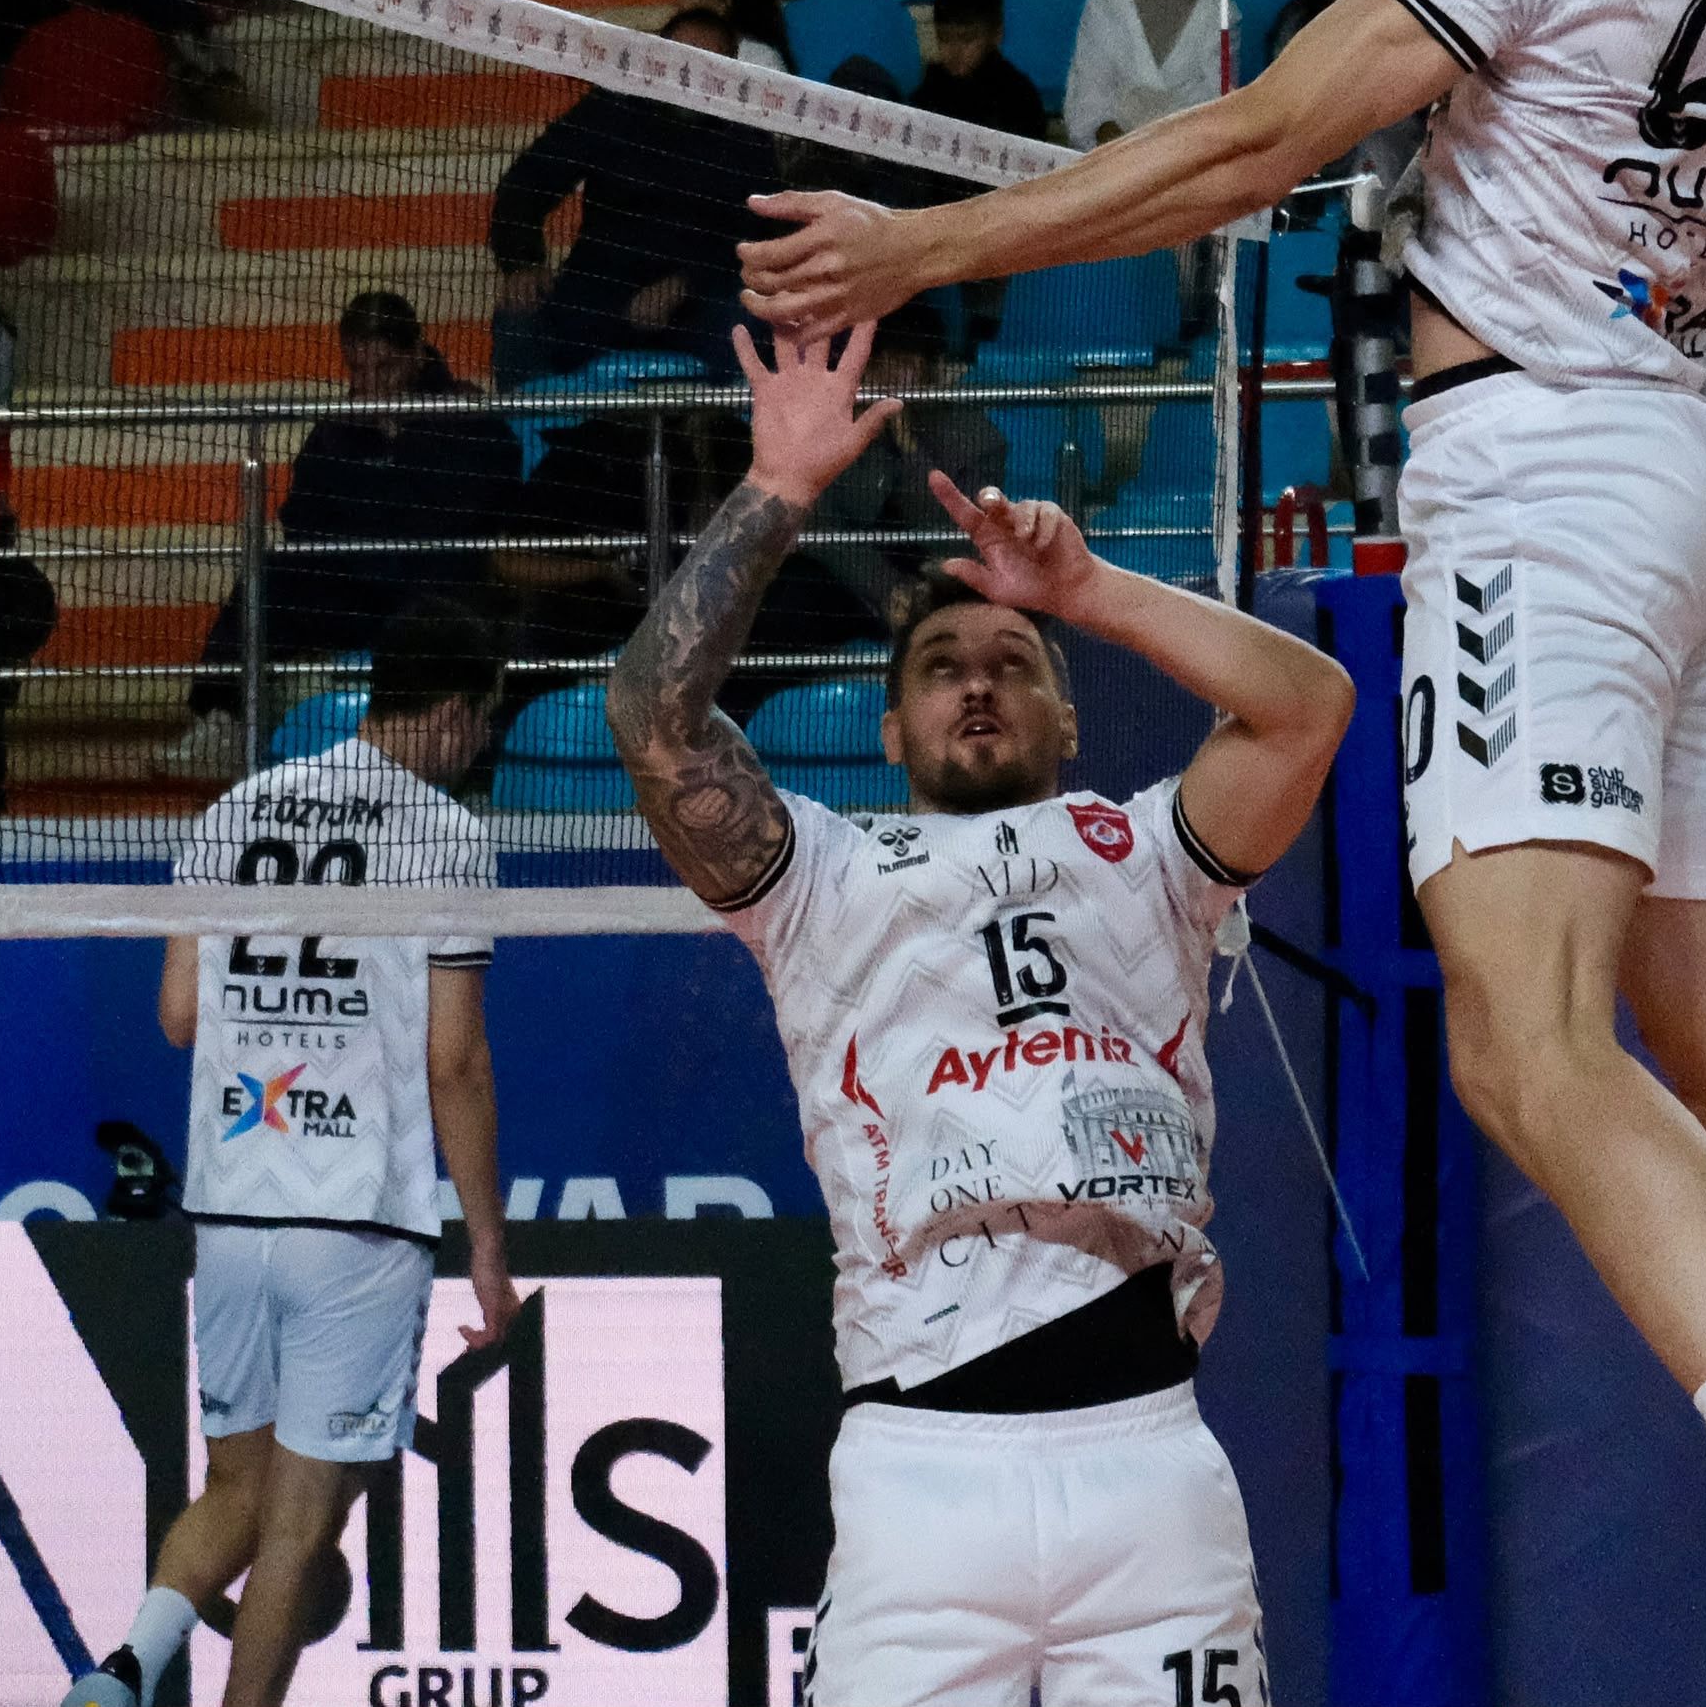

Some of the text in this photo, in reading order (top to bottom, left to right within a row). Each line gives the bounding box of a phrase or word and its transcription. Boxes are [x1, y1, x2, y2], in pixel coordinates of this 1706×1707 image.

[1587, 765, 1625, 783] club
[876, 850, 931, 876] hummel
[975, 911, 1070, 1006] 15
[221, 982, 369, 1017] numa
[236, 1030, 347, 1050] HOTELS
[221, 1062, 357, 1142] EXTRA
[302, 1122, 356, 1139] MALL
[930, 1139, 998, 1181] DAY
[930, 1174, 1005, 1214] ONE
[1056, 1174, 1197, 1203] VORTEX
[370, 1666, 550, 1707] GRUP
[1162, 1648, 1243, 1707] 15
